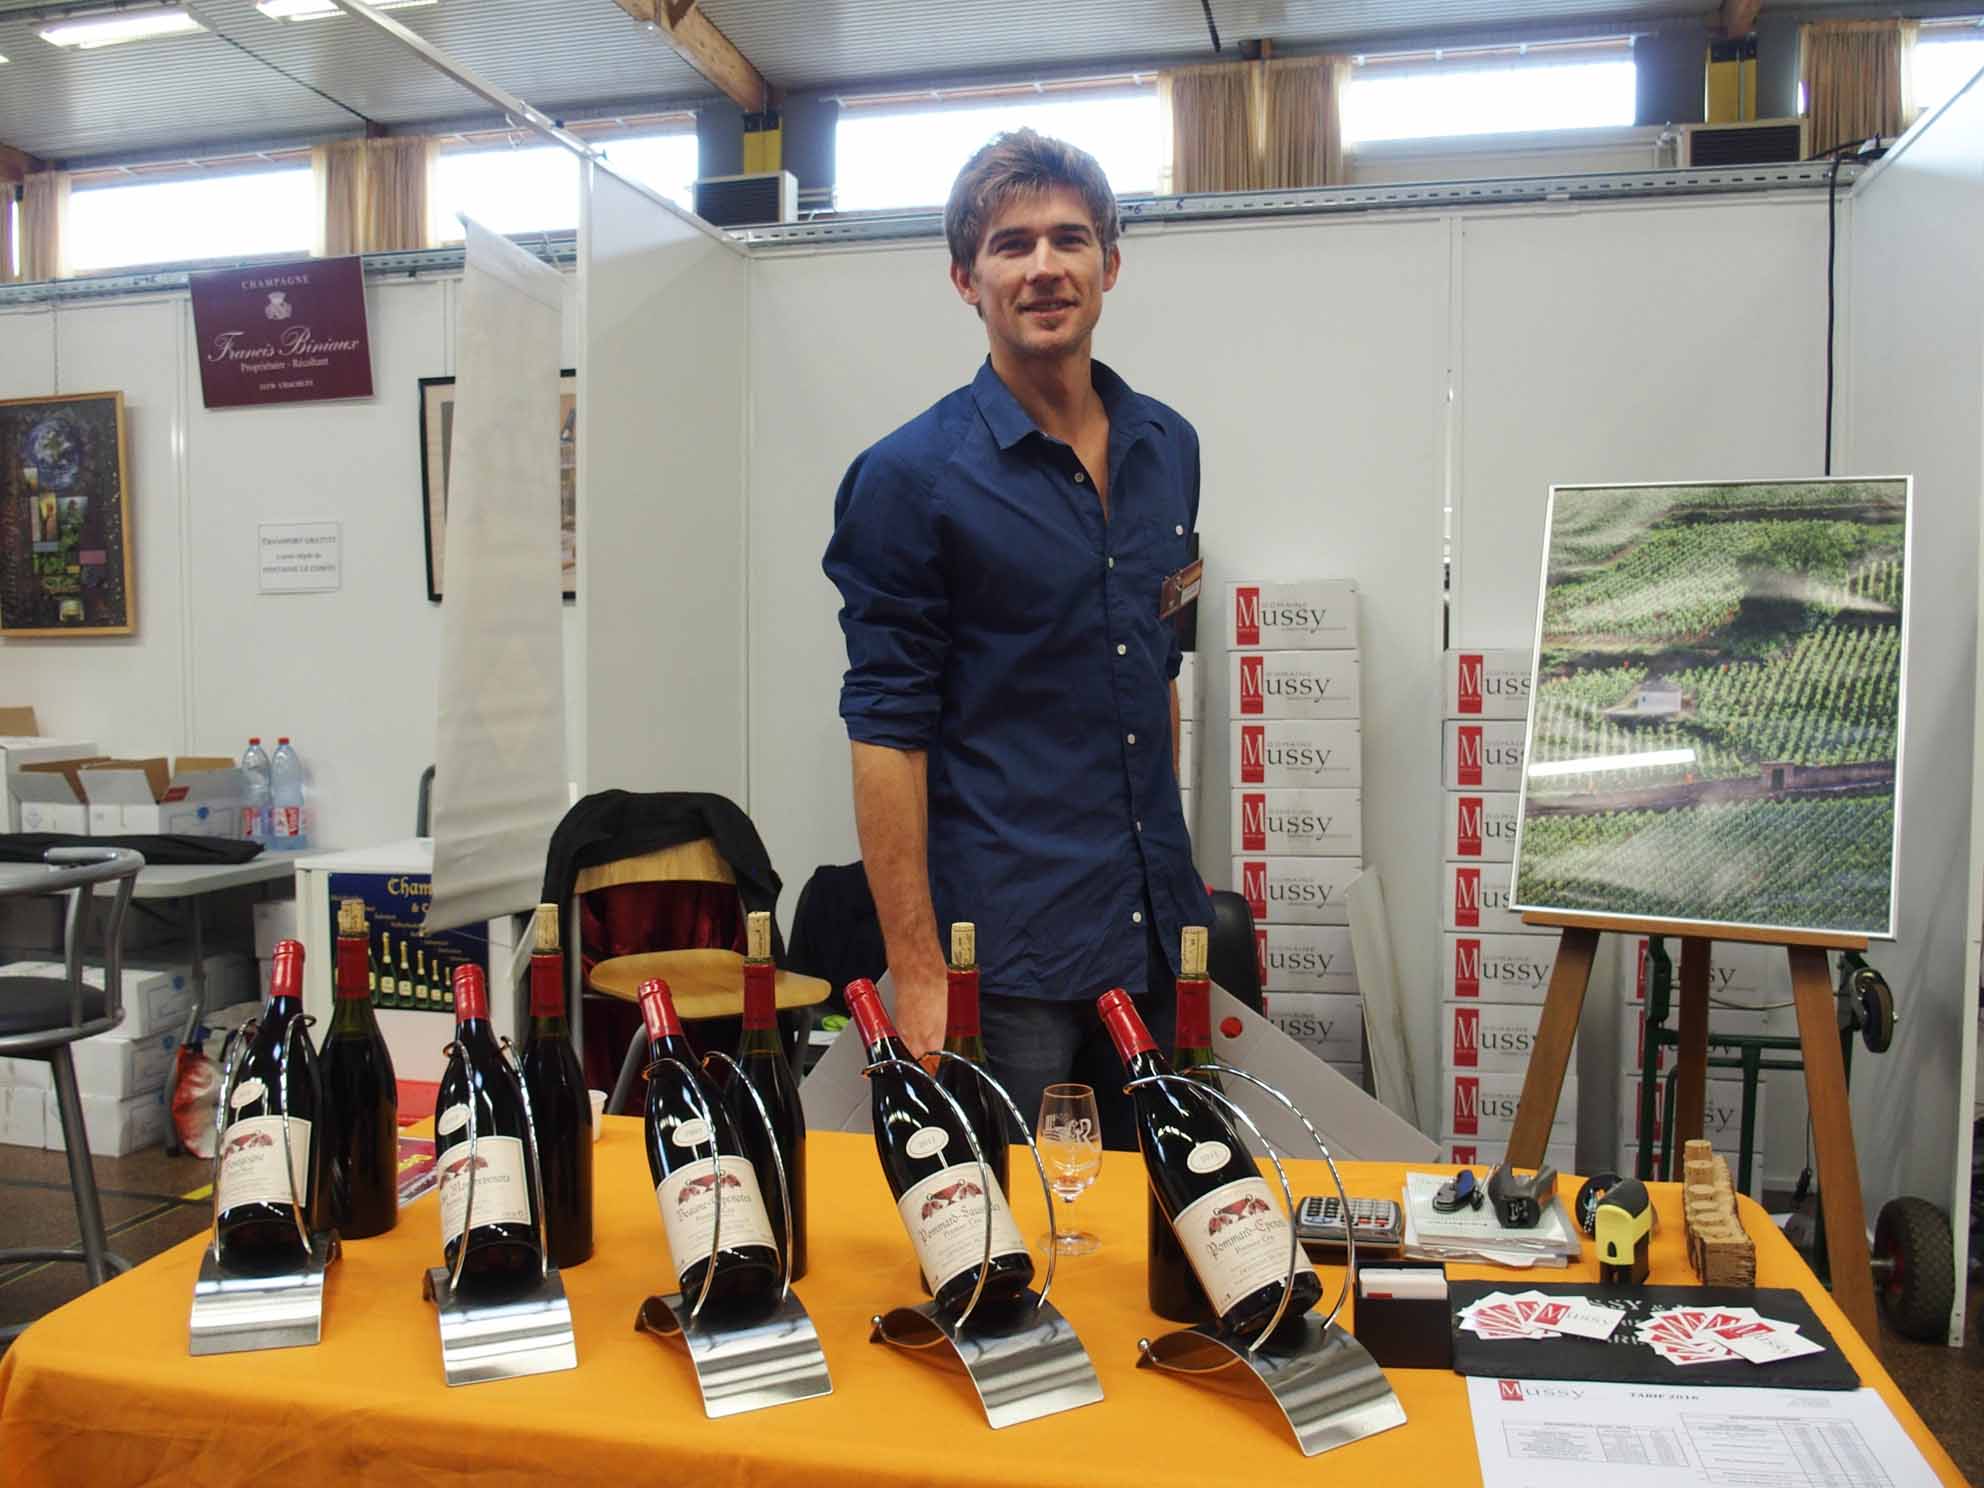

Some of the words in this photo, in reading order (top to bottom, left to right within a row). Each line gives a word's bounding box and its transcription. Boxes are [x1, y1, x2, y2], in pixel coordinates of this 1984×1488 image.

[241, 275, 310, 289] CHAMPAGNE
[208, 331, 275, 362] Francis
[1238, 596, 1326, 634] Mussy
[1242, 664, 1330, 703] Mussy
[1243, 734, 1331, 774] Mussy
[1460, 735, 1524, 765] Mus
[1244, 802, 1332, 841] Mussy
[1245, 871, 1333, 909] Mussy
[1458, 948, 1549, 989] Mussy
[1456, 1017, 1536, 1050] Muss
[1456, 1085, 1520, 1118] Mus
